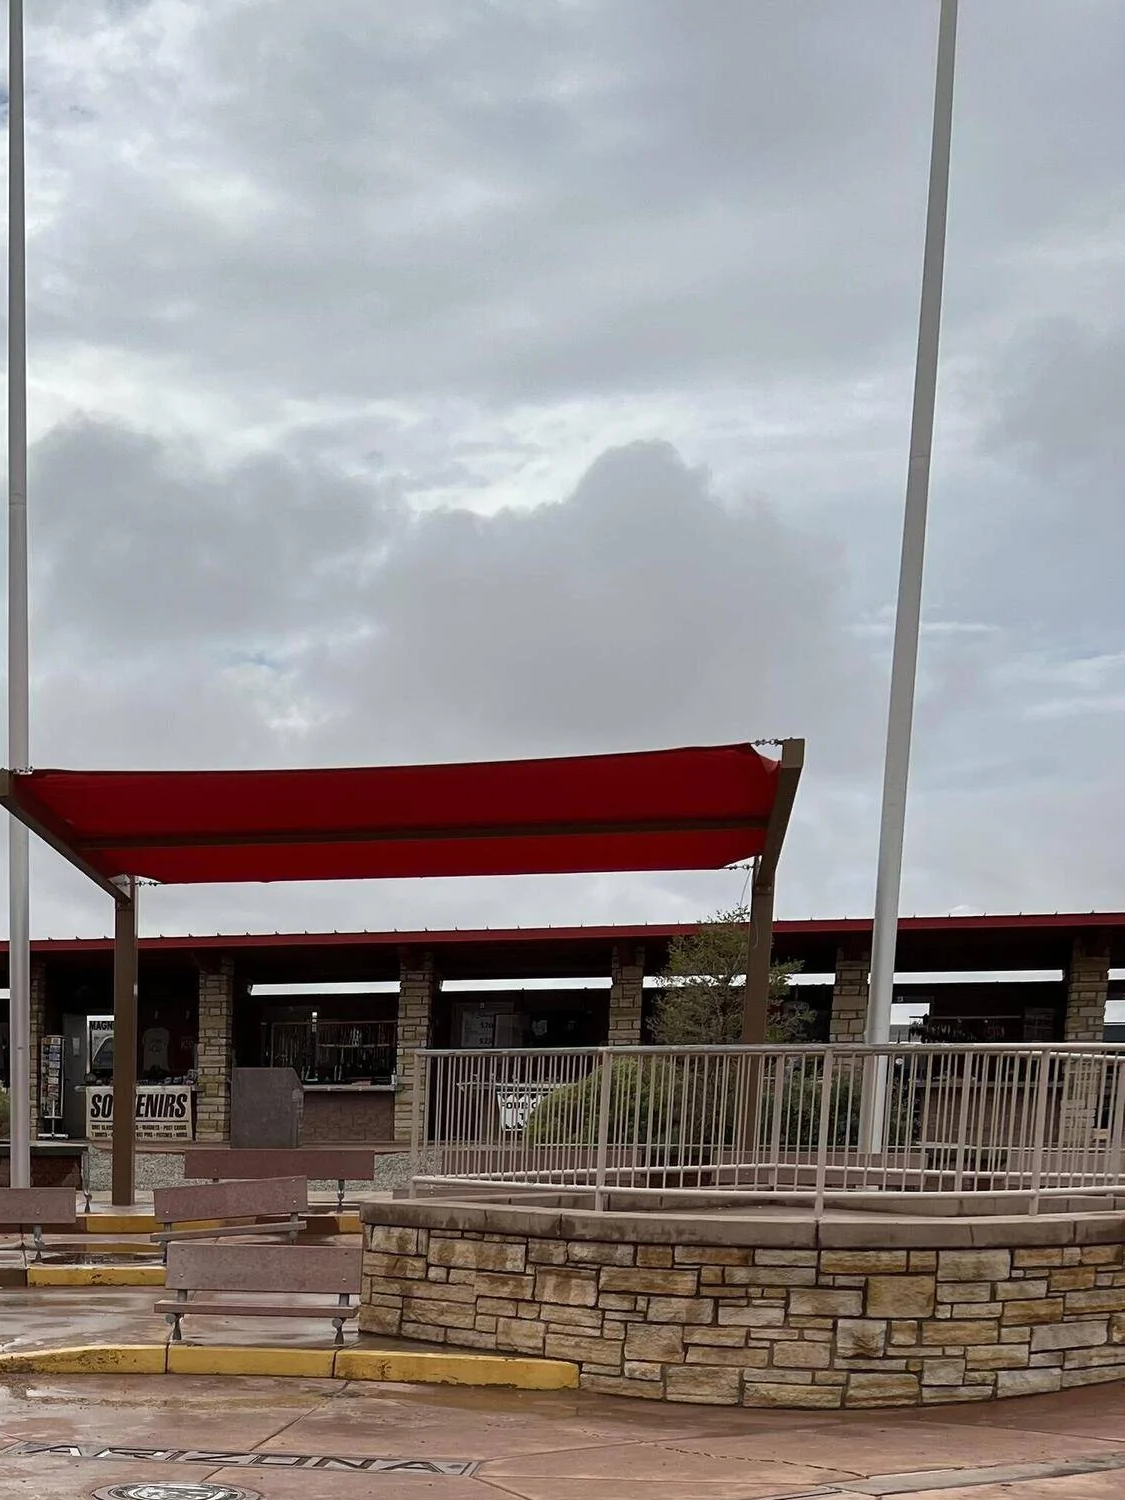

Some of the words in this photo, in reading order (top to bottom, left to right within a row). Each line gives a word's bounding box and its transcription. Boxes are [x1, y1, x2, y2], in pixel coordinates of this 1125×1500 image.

[89, 1021, 114, 1031] MAGN
[90, 1093, 187, 1118] SOENIRS
[24, 1444, 444, 1475] ARIZONA
